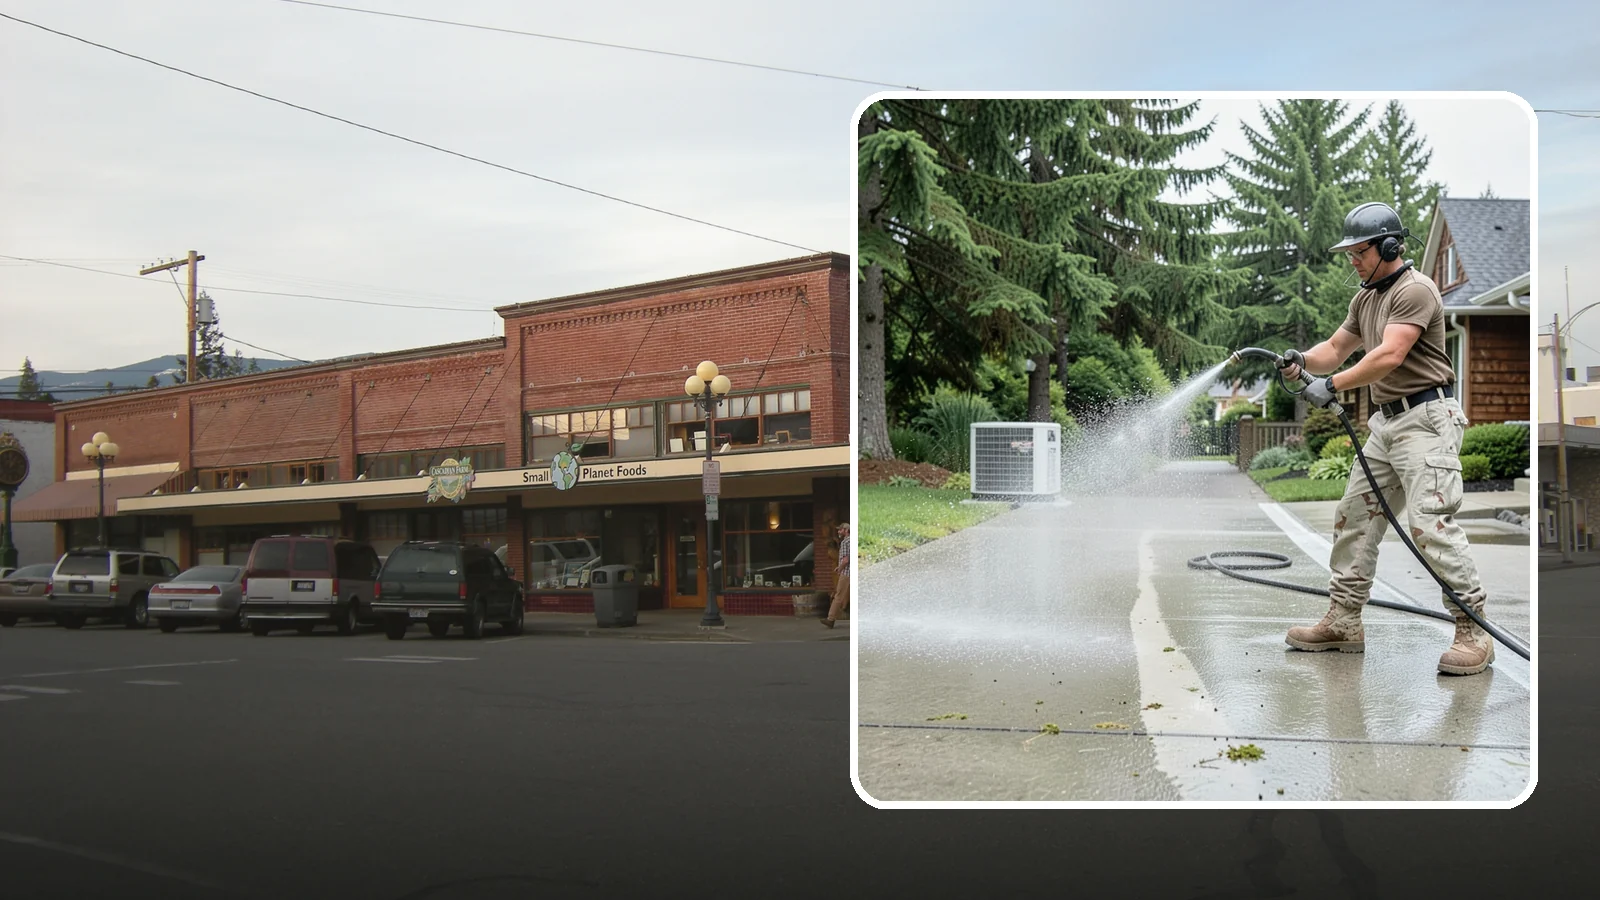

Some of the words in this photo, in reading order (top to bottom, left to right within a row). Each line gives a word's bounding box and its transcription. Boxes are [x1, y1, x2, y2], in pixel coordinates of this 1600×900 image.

[523, 471, 549, 483] Small
[582, 467, 614, 479] Planet
[616, 464, 647, 477] Foods
